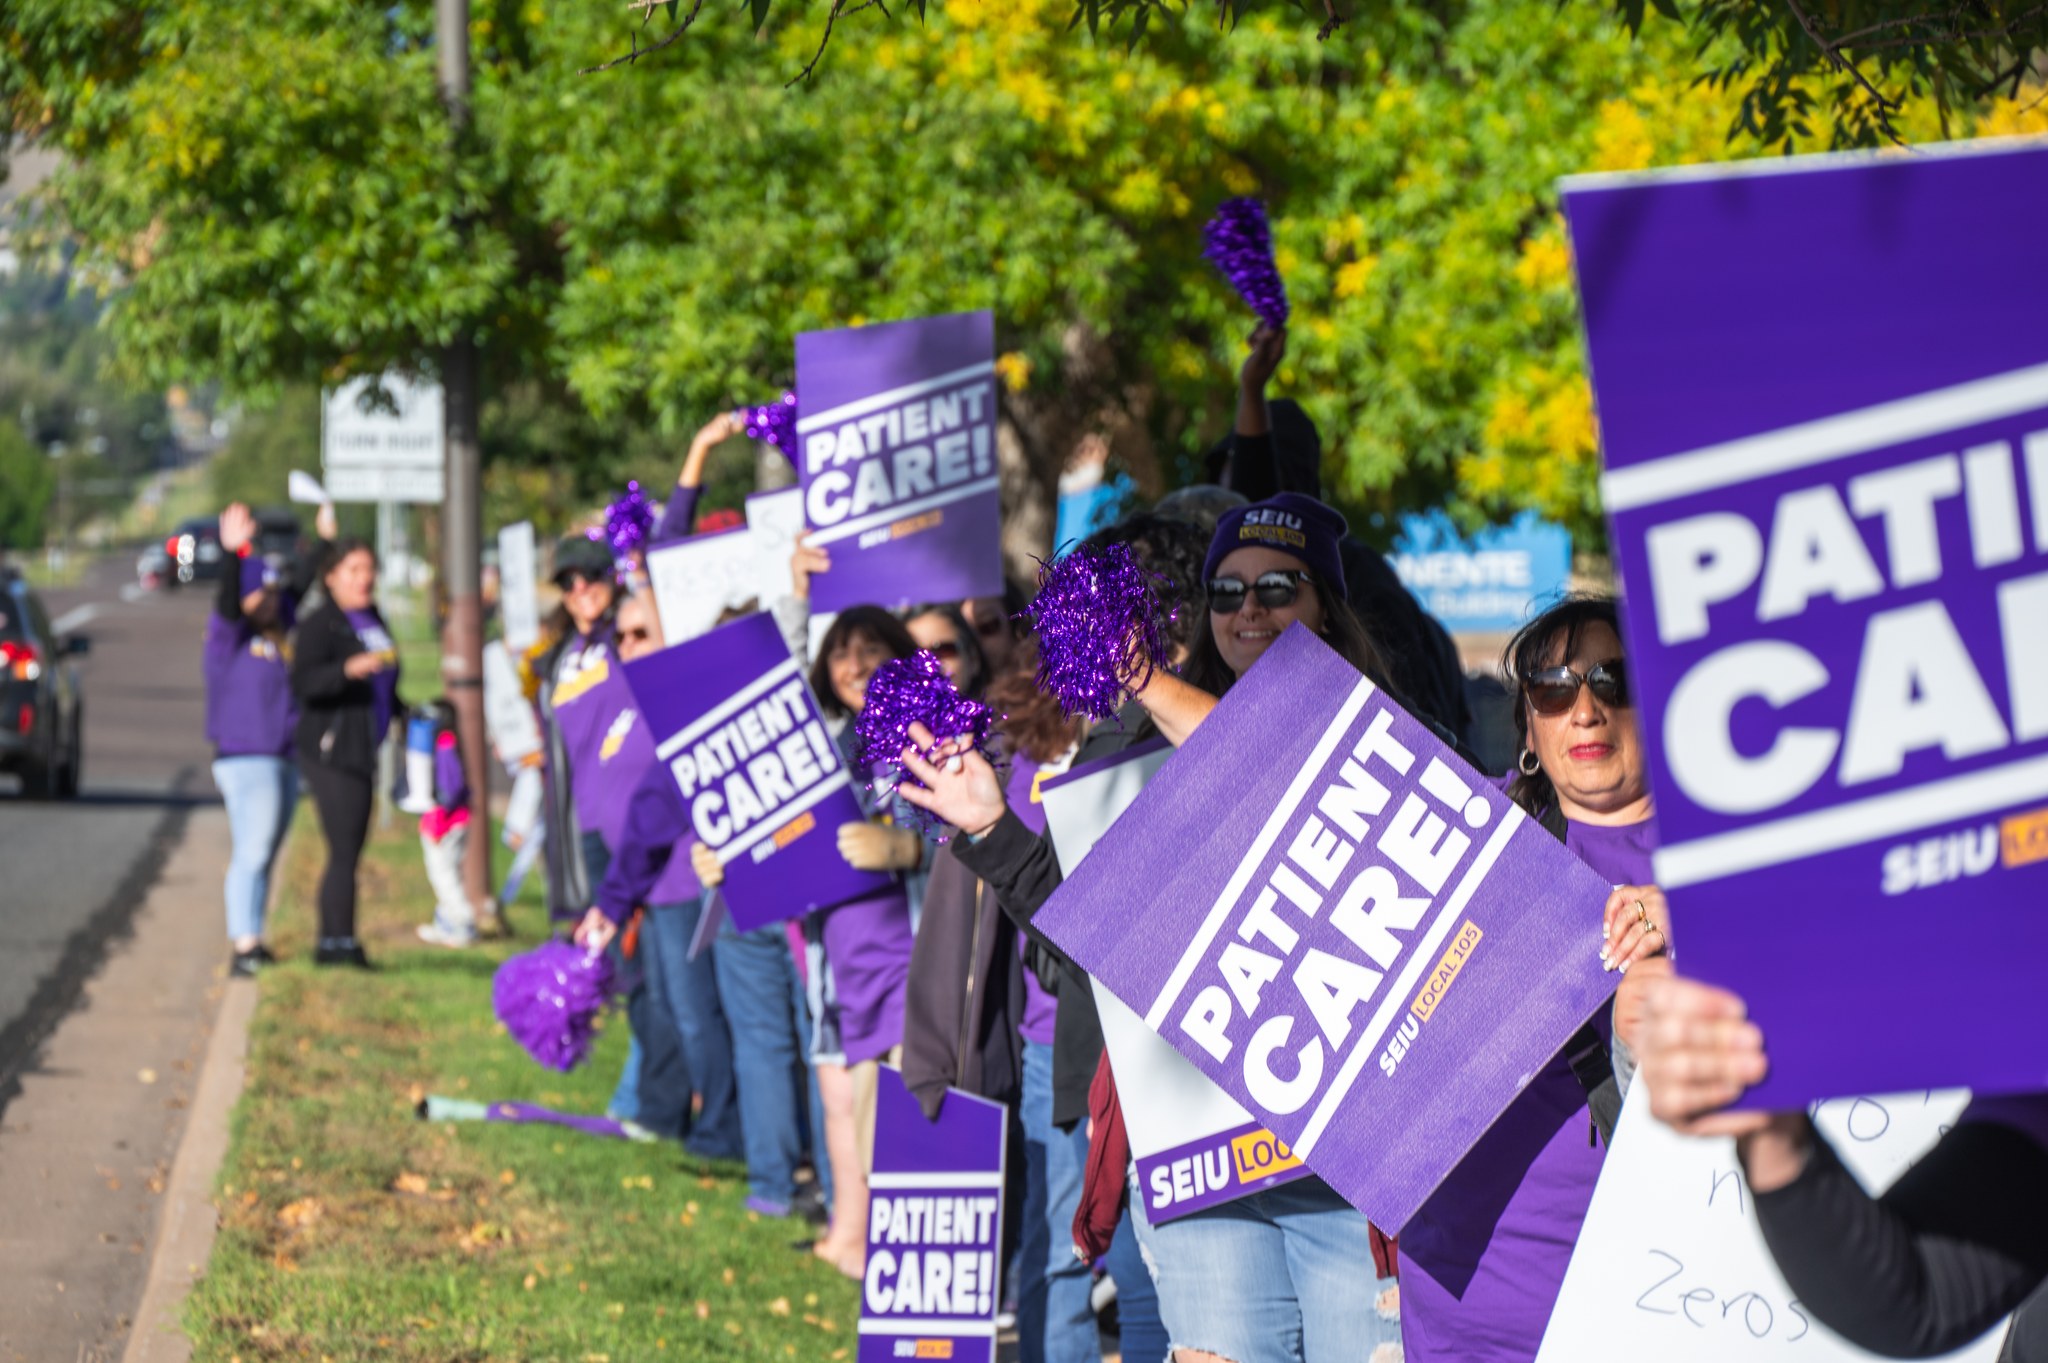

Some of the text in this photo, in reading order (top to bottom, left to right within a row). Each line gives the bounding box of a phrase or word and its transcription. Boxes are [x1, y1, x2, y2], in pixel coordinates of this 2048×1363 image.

[805, 381, 990, 475] PATIENT
[806, 424, 991, 526] CARE!
[1243, 508, 1303, 530] SEIU
[670, 677, 809, 800] PATIENT
[691, 718, 837, 847] CARE!
[1179, 707, 1416, 1064] PATIENT
[1880, 823, 1999, 896] SEIU
[1242, 755, 1492, 1115] CARE!
[1379, 926, 1478, 1079] SEIU LOCAL 105
[869, 1196, 998, 1245] PATIENT
[1150, 1144, 1231, 1209] SEIU
[865, 1248, 994, 1316] CARE!
[1635, 1248, 1810, 1342] Zeros
